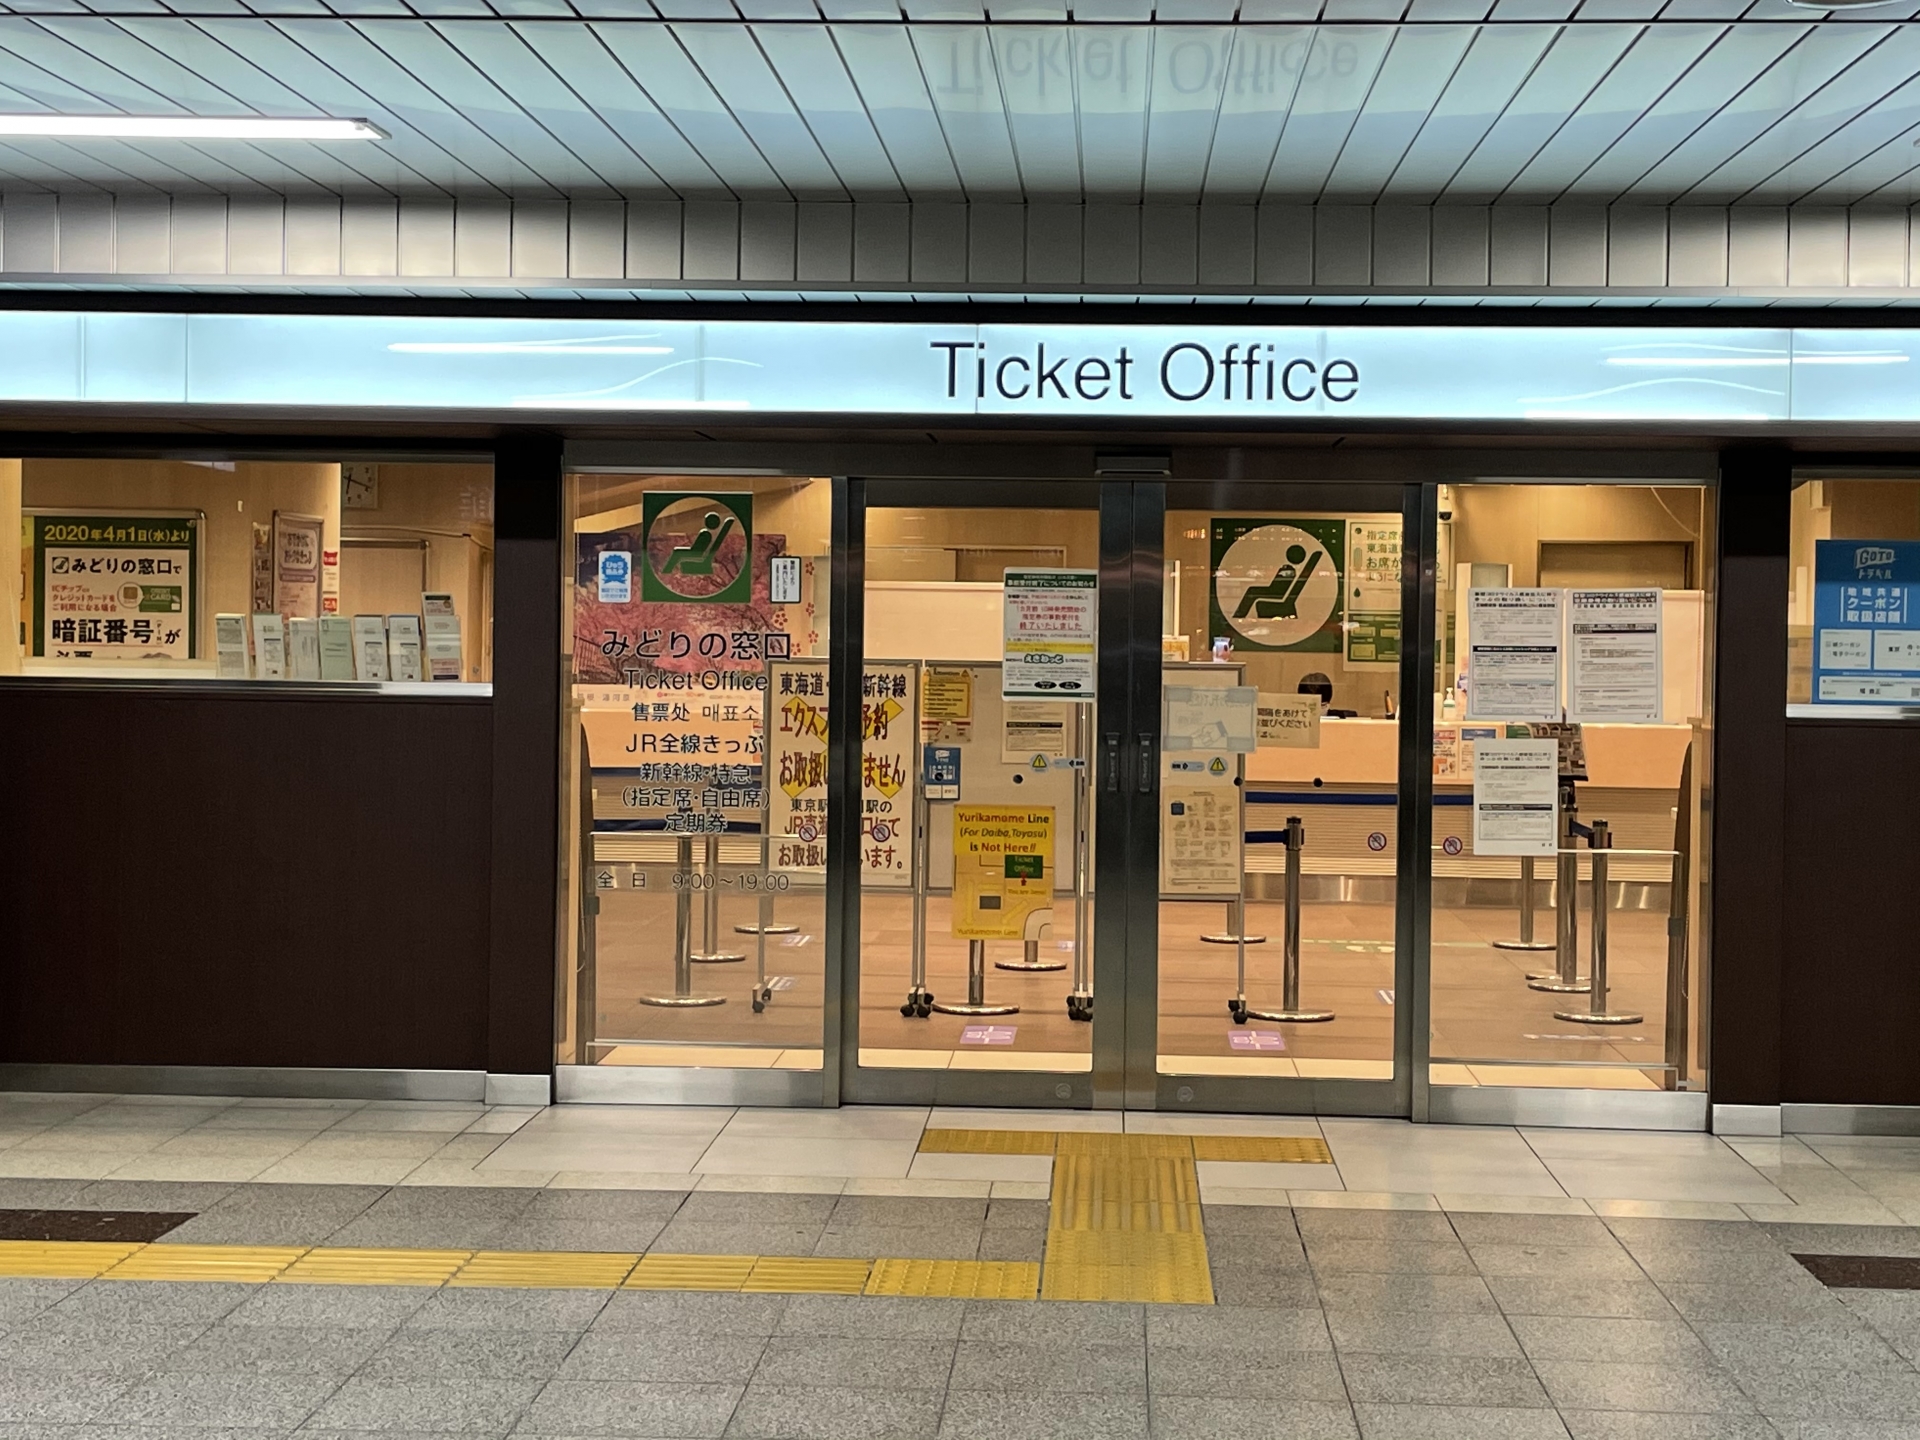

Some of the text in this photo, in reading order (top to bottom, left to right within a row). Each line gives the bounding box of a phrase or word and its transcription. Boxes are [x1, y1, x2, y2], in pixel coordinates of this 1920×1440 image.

[929, 341, 1361, 402] Ticket Office
[44, 525, 190, 542] 2020年4月1日(水)より
[1858, 568, 1892, 579] トラベル
[1847, 597, 1901, 609] クーポン
[52, 618, 154, 644] 暗証番号
[601, 630, 792, 661] みどりの窓口
[623, 669, 769, 691] Ticket Office
[631, 703, 691, 722] 售票处
[702, 703, 761, 722] 매표소
[626, 733, 765, 754] JR全線きっぷ
[665, 813, 728, 833] 定期券
[958, 812, 1050, 824] Yurikamome Line
[960, 827, 979, 838] (For
[981, 842, 1001, 852] Not
